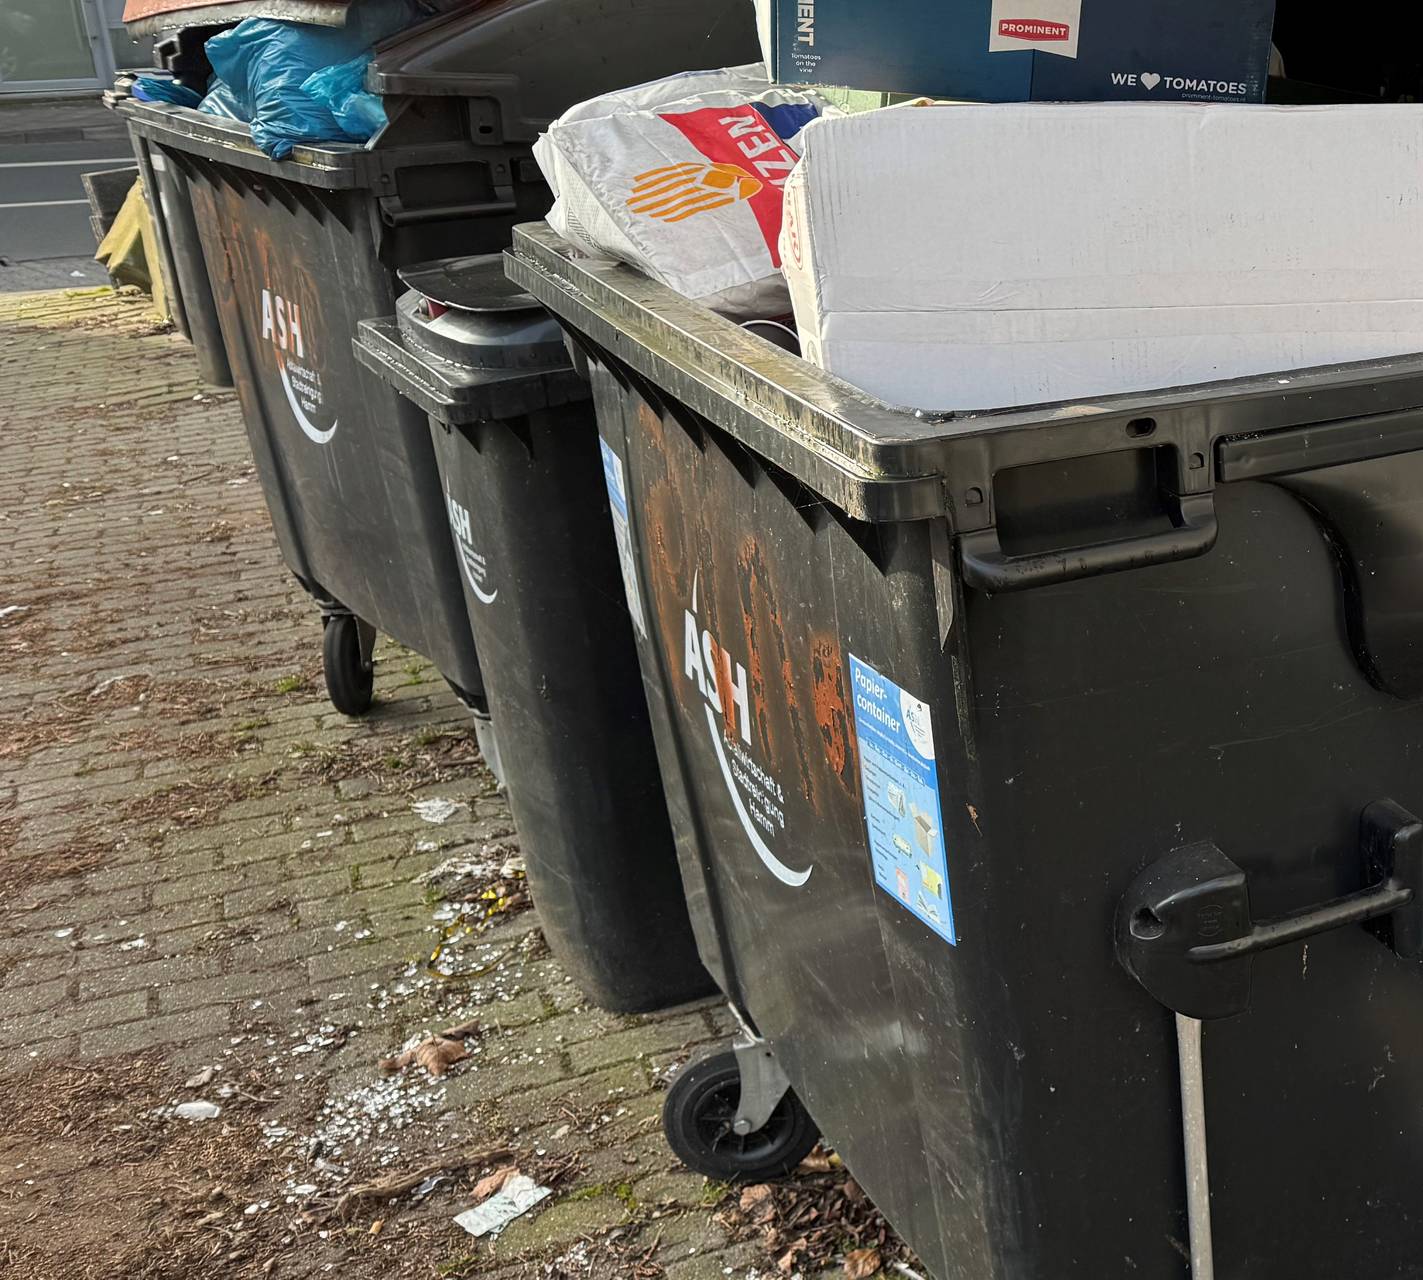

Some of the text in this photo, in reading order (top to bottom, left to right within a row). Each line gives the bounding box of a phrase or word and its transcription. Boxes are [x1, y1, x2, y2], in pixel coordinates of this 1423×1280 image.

[798, 0, 815, 47] ENT
[1001, 23, 1067, 36] PROMINENT
[791, 53, 822, 61] Tomatoes
[805, 60, 816, 68] the
[1111, 73, 1247, 95] WE TOMATOES
[262, 288, 304, 358] ASH
[684, 609, 752, 746] ASH
[855, 667, 888, 700] Papier-
[857, 694, 901, 734] container
